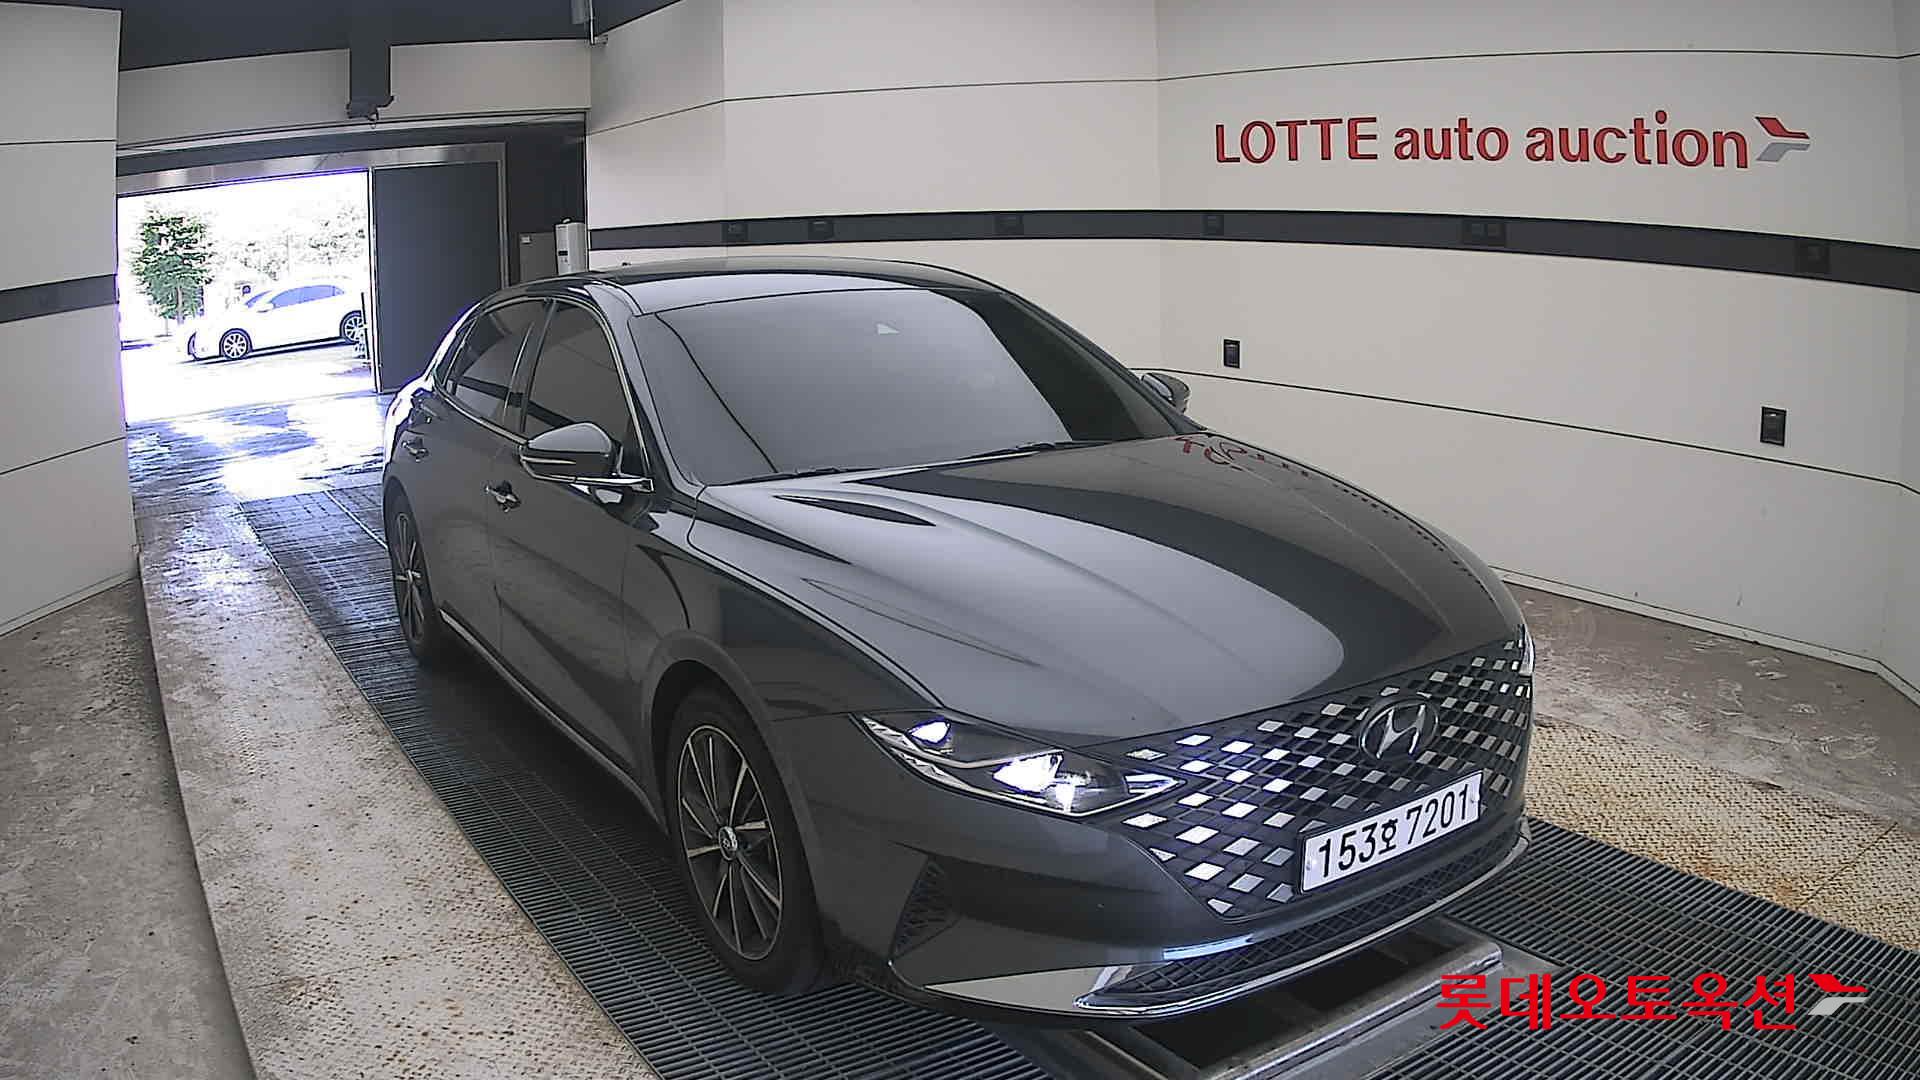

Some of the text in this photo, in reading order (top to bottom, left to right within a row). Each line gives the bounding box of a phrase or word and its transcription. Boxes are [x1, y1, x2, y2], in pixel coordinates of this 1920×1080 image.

[1215, 110, 1749, 169] LOTTE auto auction
